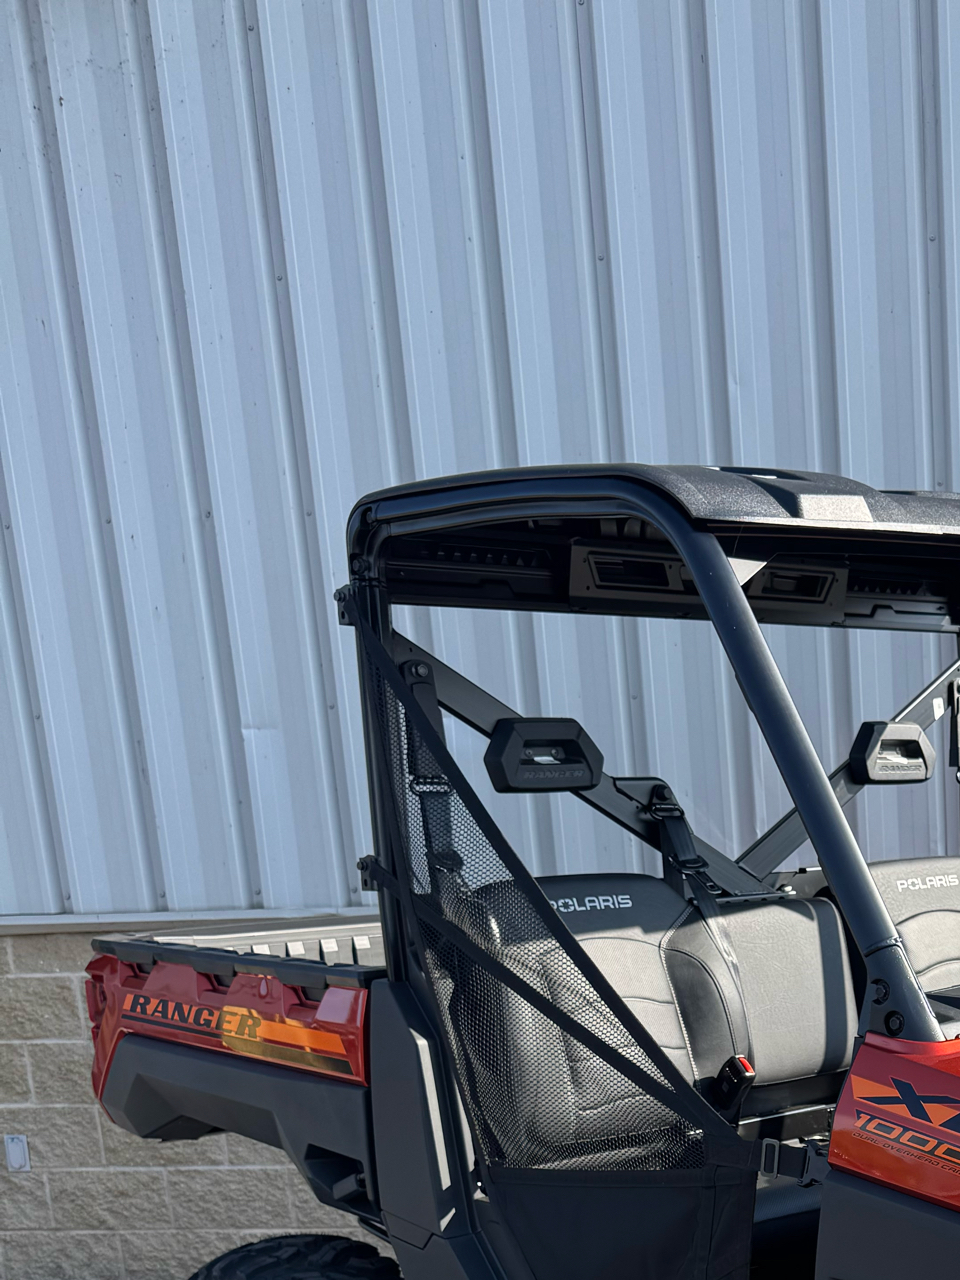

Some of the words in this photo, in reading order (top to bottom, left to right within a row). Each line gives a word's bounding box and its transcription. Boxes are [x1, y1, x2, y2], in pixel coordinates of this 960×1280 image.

[523, 769, 584, 780] RANGER
[896, 874, 959, 893] POLARIS
[129, 994, 262, 1039] RANGER
[852, 1131, 879, 1145] DUAL
[881, 1142, 940, 1167] OVERHEAD
